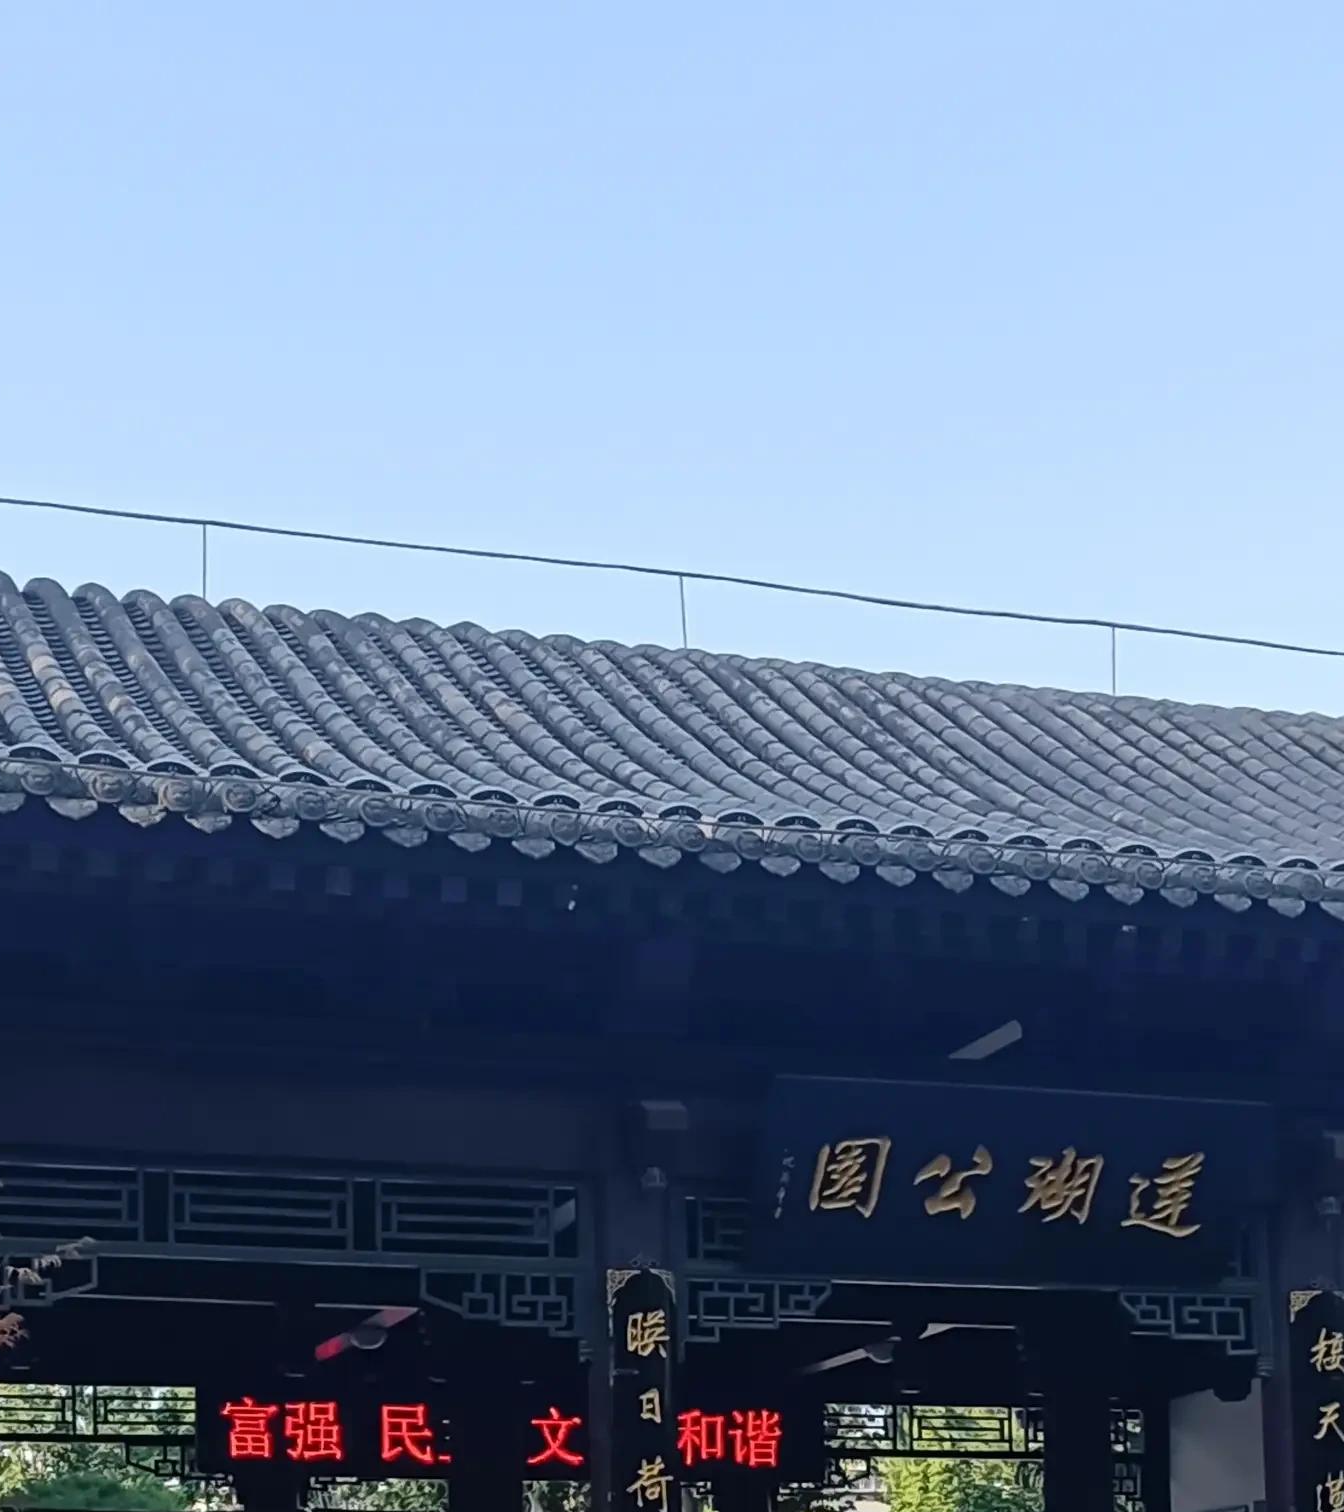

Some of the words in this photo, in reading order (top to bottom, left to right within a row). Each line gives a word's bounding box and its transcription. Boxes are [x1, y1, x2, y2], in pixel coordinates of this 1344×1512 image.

[221, 1397, 342, 1461] 富强
[380, 1404, 452, 1464] 民
[677, 1409, 781, 1467] 和谐
